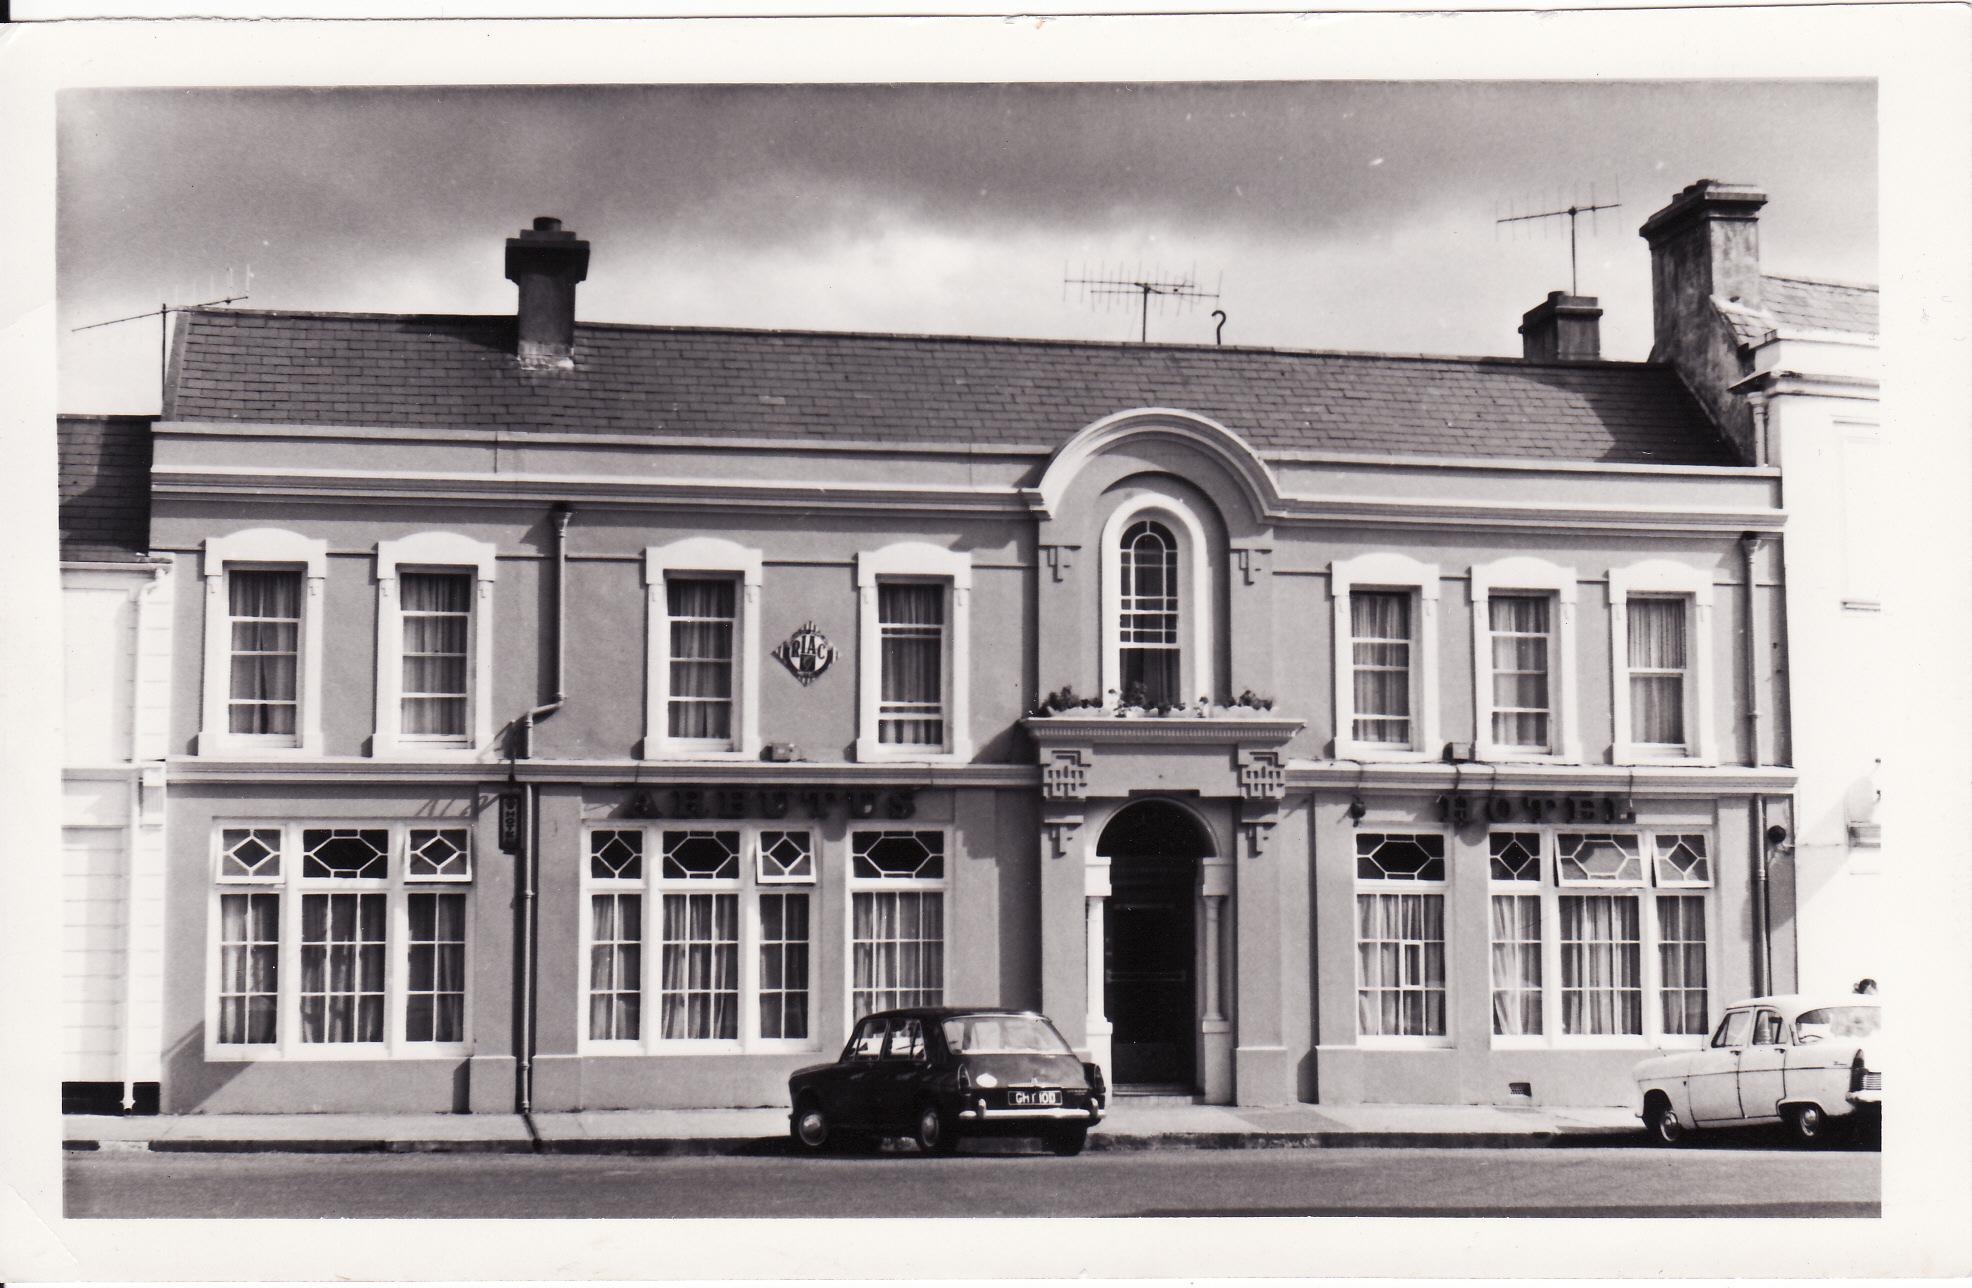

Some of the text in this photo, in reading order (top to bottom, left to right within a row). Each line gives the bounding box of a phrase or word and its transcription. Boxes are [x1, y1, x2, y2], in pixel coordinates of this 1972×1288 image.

[790, 635, 826, 660] RIAC
[622, 789, 1636, 824] ARBUTUS HOTEL
